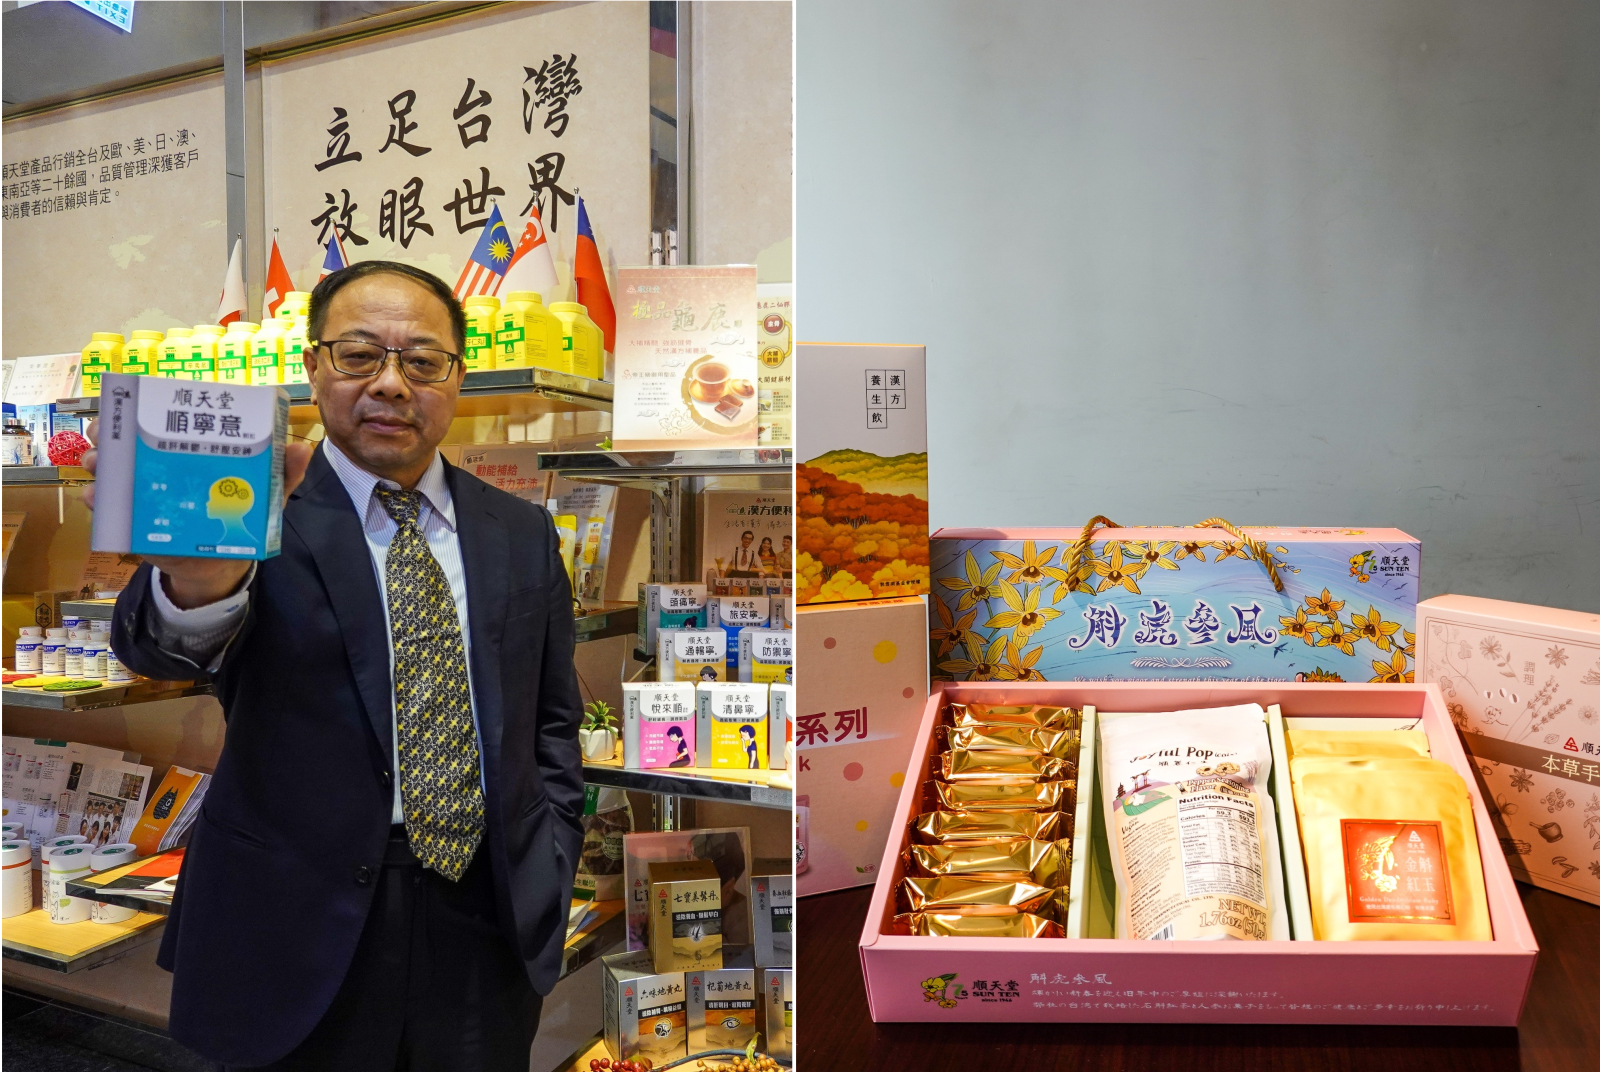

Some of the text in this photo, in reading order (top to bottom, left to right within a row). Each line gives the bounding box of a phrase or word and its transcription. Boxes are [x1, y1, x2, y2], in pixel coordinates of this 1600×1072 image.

[314, 53, 582, 172] 立足台灣
[311, 152, 586, 249] 放眼世界
[172, 388, 235, 410] 順天堂
[166, 409, 242, 438] 順寧意
[476, 464, 518, 477] 動能補給
[495, 477, 538, 490] 活力充沛
[1380, 555, 1410, 566] 順天堂
[672, 588, 694, 596] 順天堂
[732, 601, 755, 609] 順天堂
[729, 610, 759, 620] 旅安寧
[687, 636, 712, 644] 順天堂
[764, 637, 789, 646] 順天堂
[653, 693, 679, 702] 順天堂
[725, 694, 751, 703] 順天堂
[723, 704, 754, 715] 清鼻寧
[1187, 746, 1213, 762] Pop
[1541, 754, 1600, 783] 本草手
[1179, 794, 1254, 807] Nutrition Facts
[1407, 876, 1436, 892] 紅玉
[1200, 911, 1242, 929] 1.76oz
[972, 980, 1020, 992] 順天堂
